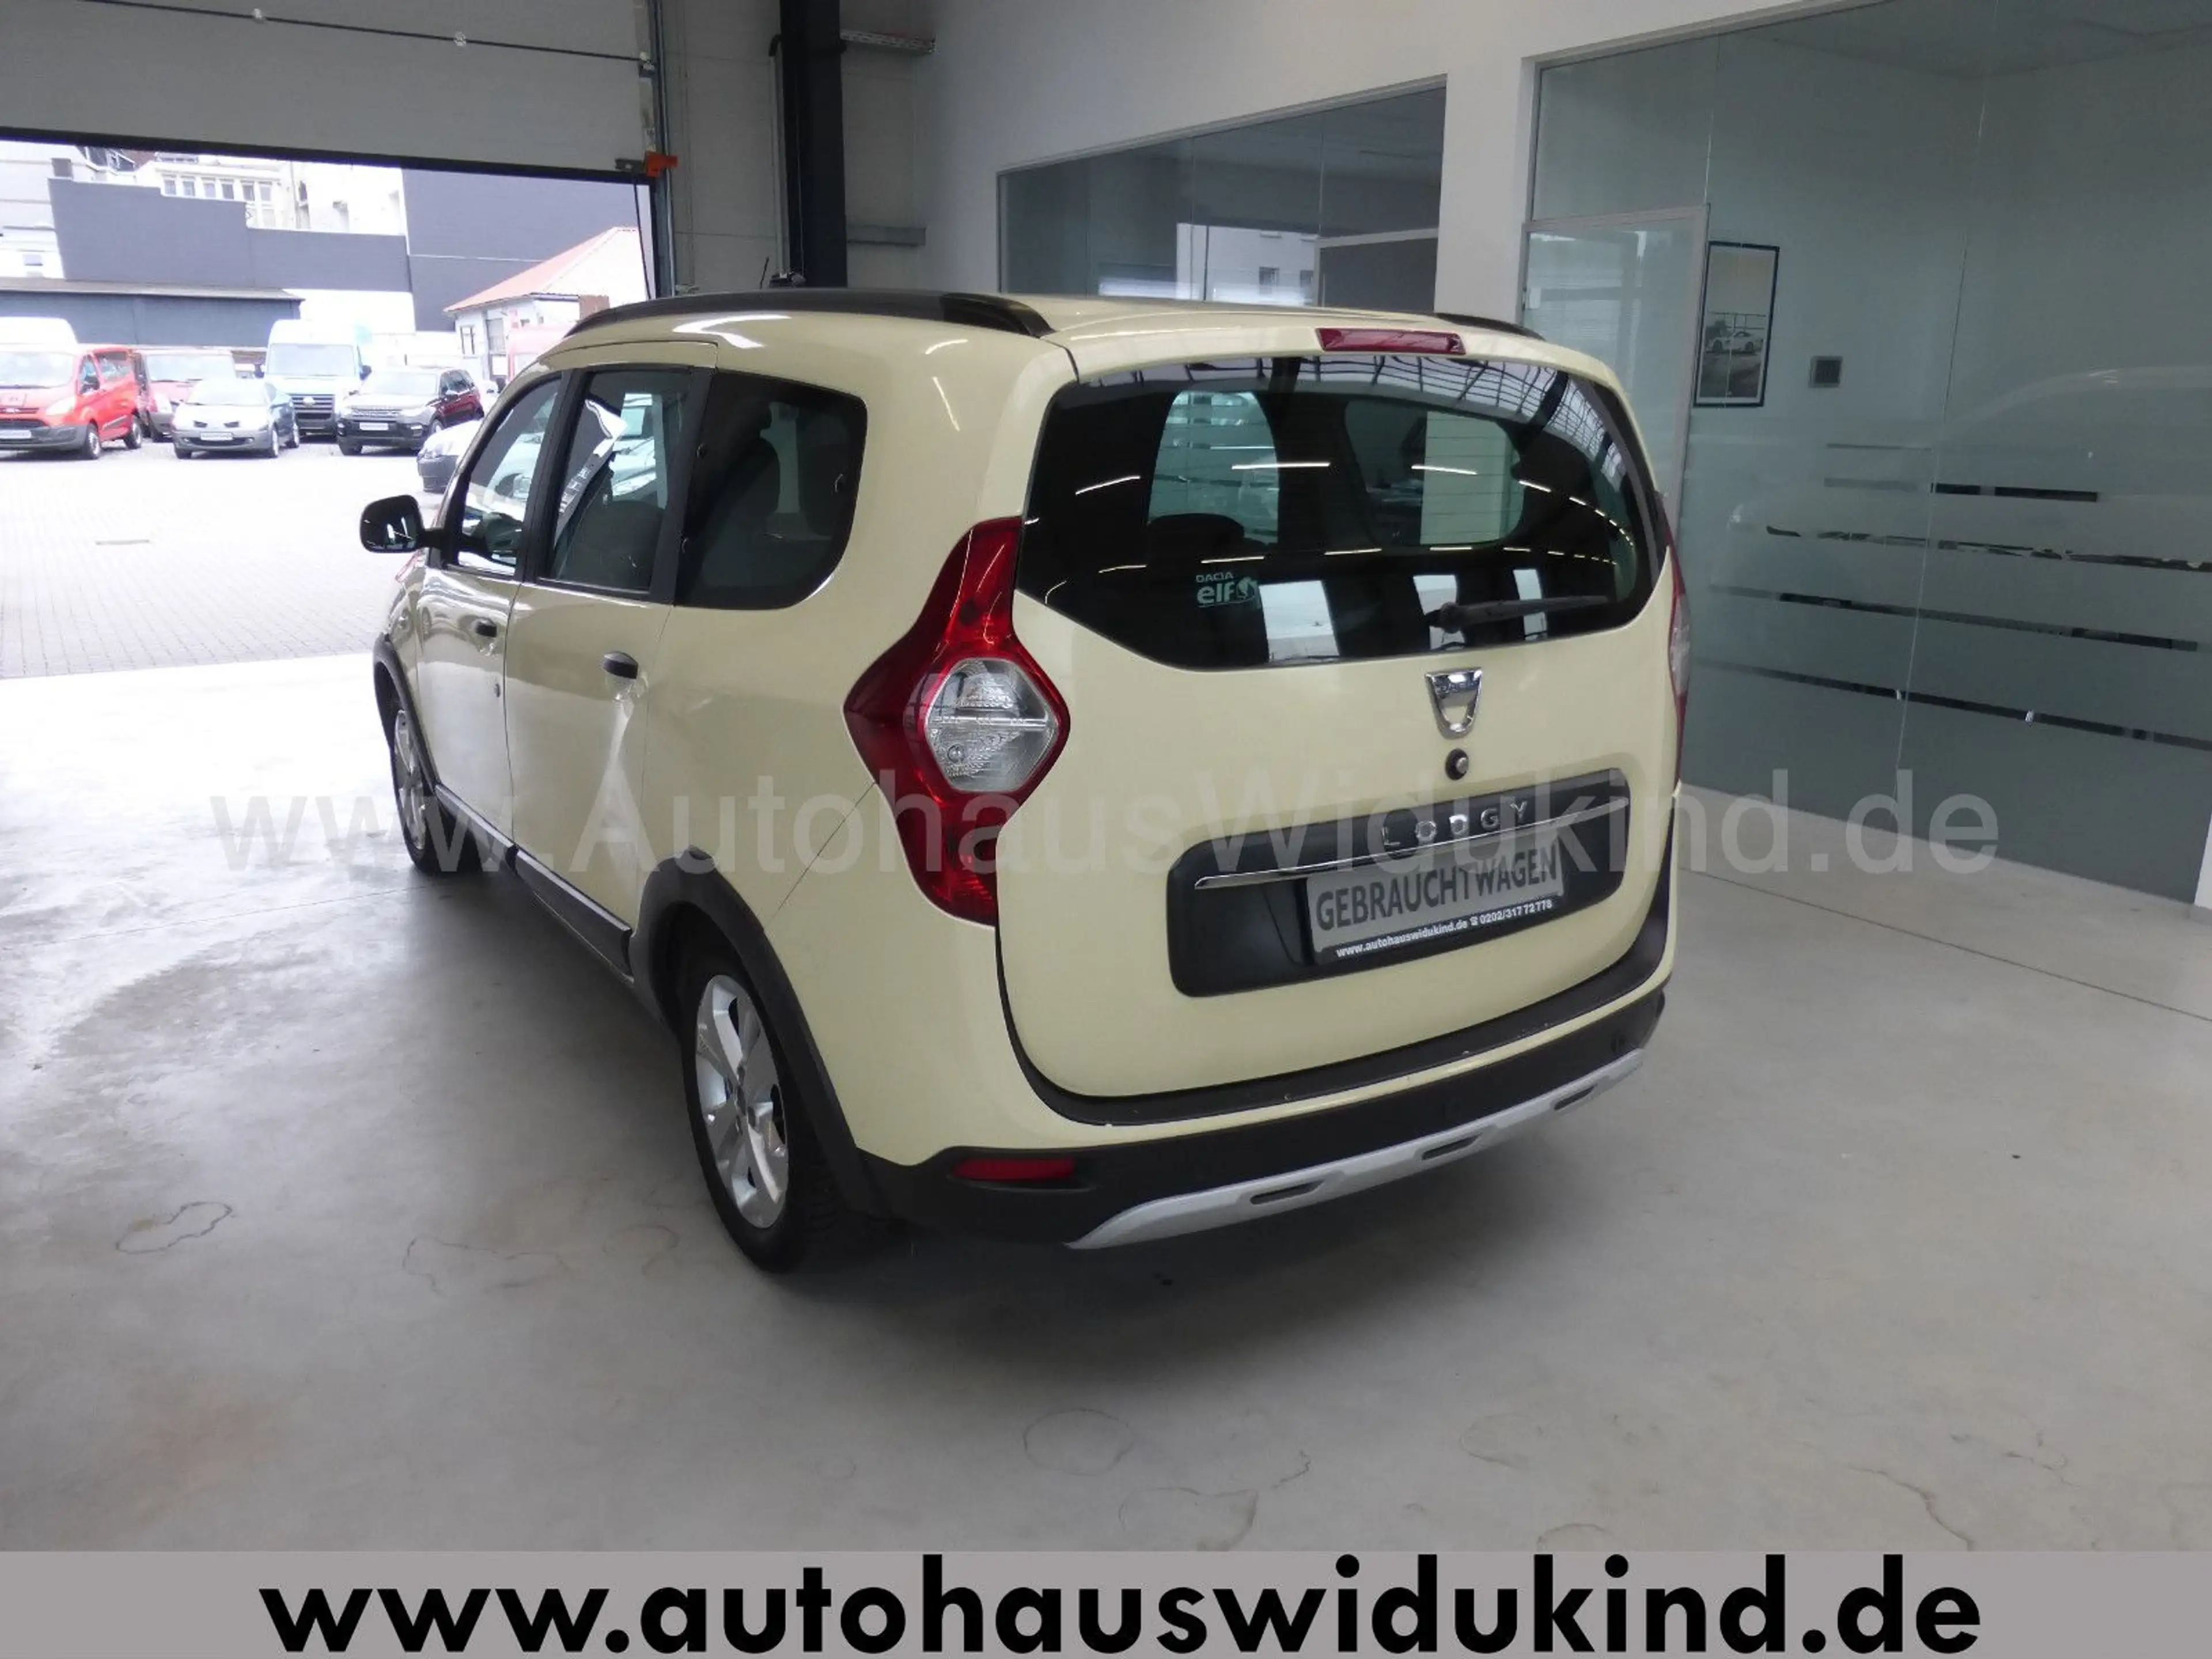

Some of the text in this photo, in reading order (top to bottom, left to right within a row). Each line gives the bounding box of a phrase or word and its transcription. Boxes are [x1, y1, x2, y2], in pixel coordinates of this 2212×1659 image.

[1195, 571, 1234, 583] DACIA
[1196, 581, 1235, 604] elf
[1381, 798, 1527, 846] LODGY
[1316, 843, 1557, 931] GEBRAUCHTWAGEN
[1336, 918, 1468, 957] www.autohauswidukind.de
